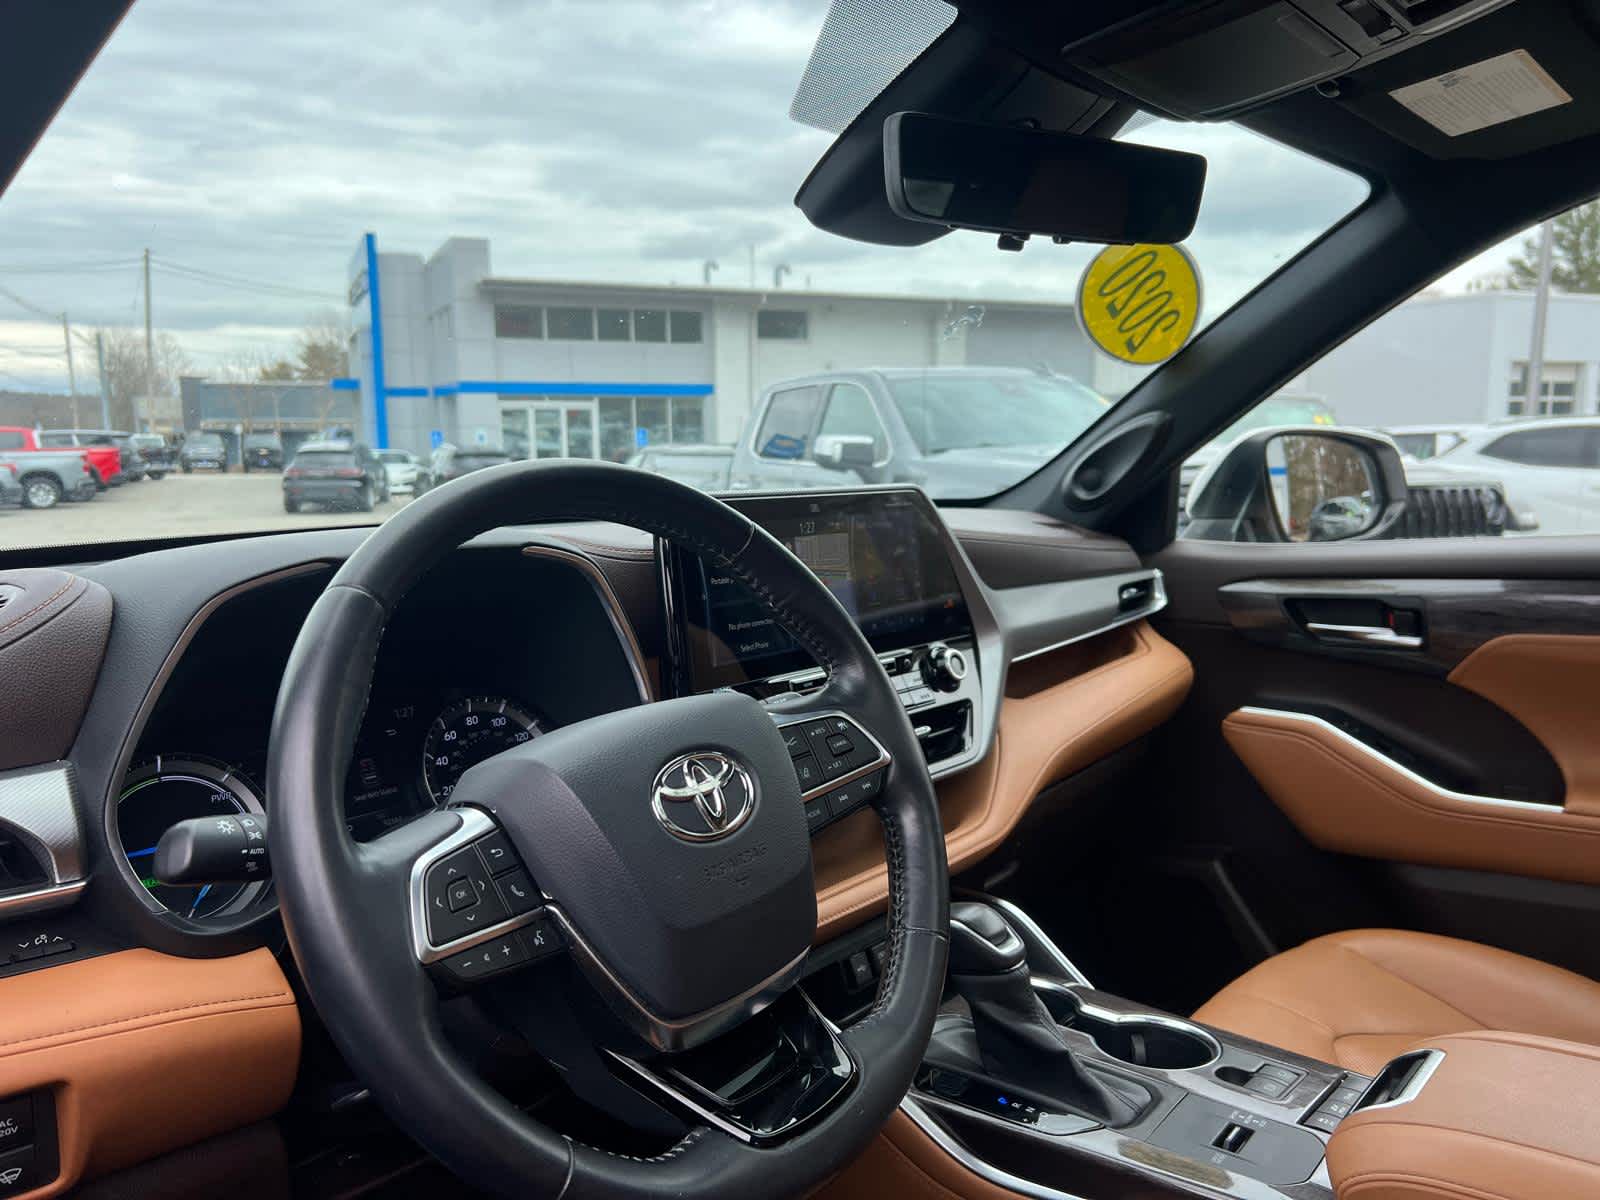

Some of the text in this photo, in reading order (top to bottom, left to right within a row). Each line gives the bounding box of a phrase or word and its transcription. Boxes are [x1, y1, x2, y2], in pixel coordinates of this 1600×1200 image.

[465, 715, 479, 726] 80
[491, 717, 506, 728] 100
[444, 729, 457, 741] 60
[515, 731, 529, 742] 120
[435, 755, 449, 766] 40
[249, 847, 265, 855] AUTO
[0, 1125, 18, 1138] 20V
